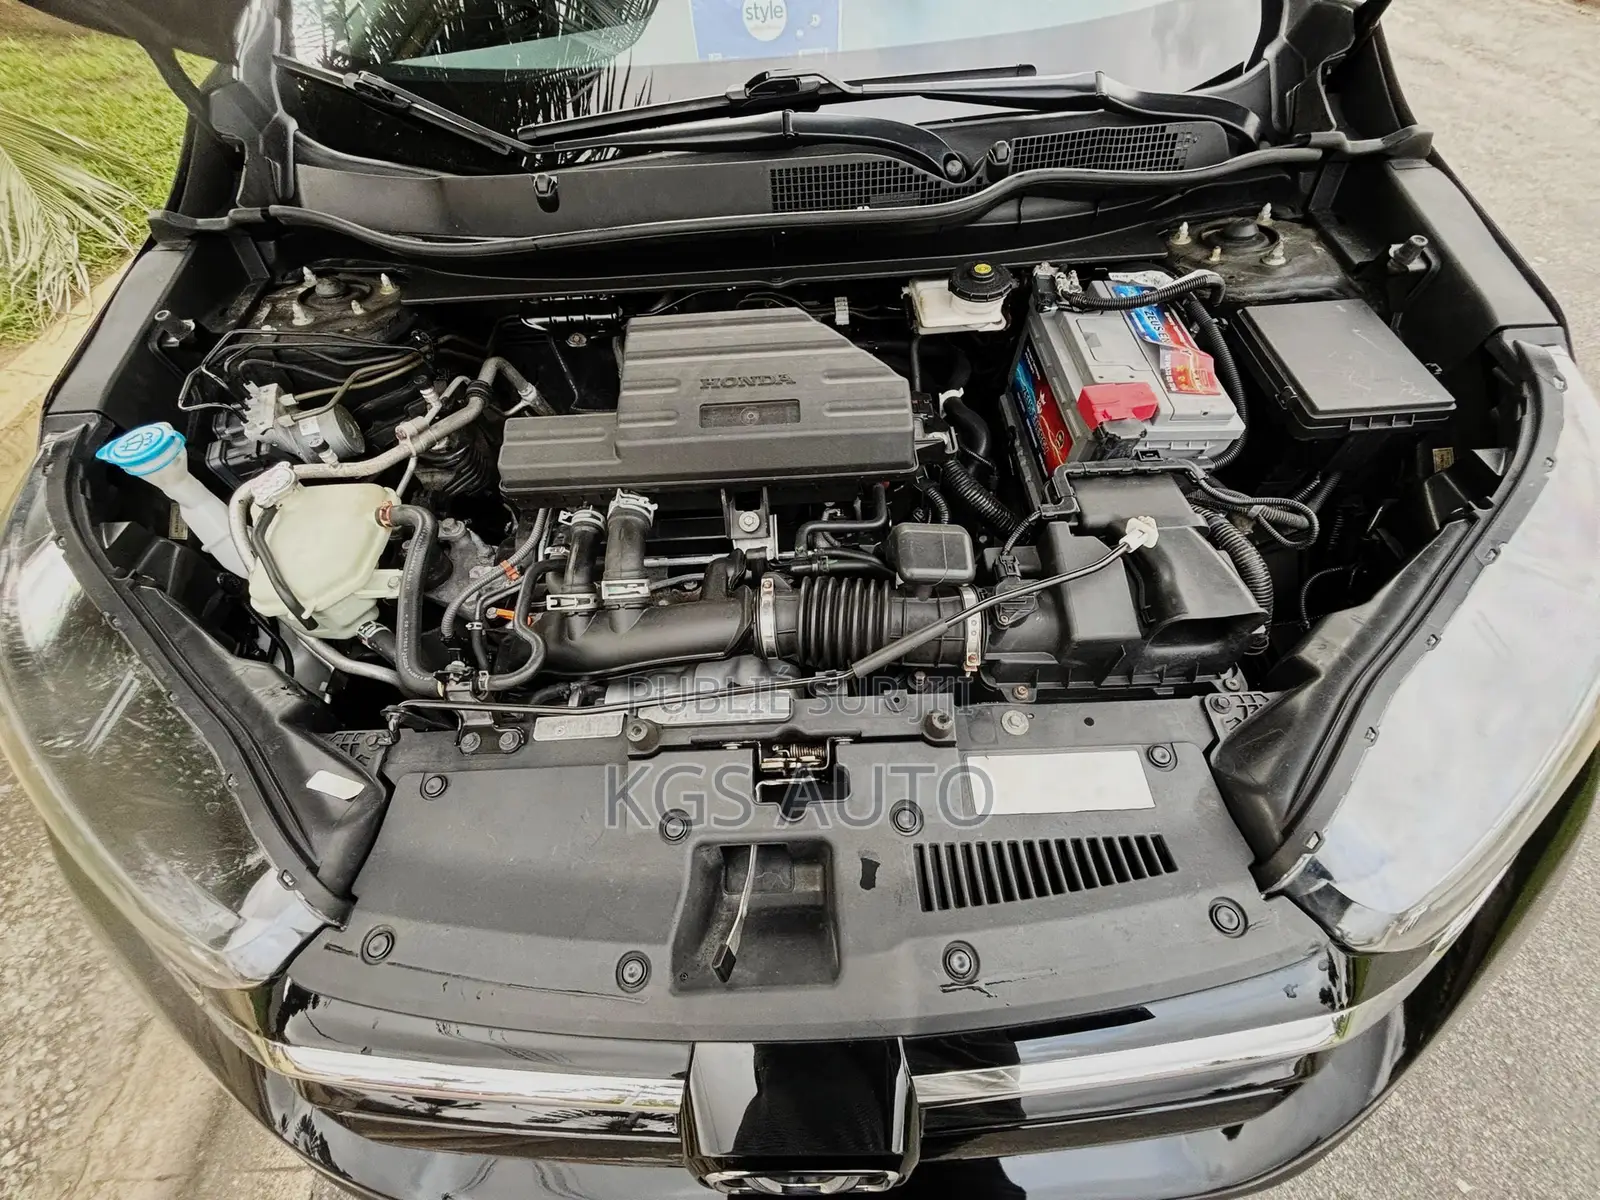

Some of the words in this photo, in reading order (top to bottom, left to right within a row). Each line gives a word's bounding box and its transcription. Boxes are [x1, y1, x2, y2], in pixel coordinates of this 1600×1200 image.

[745, 0, 784, 24] style
[1144, 309, 1164, 333] ZEUS
[699, 373, 797, 390] HONDA
